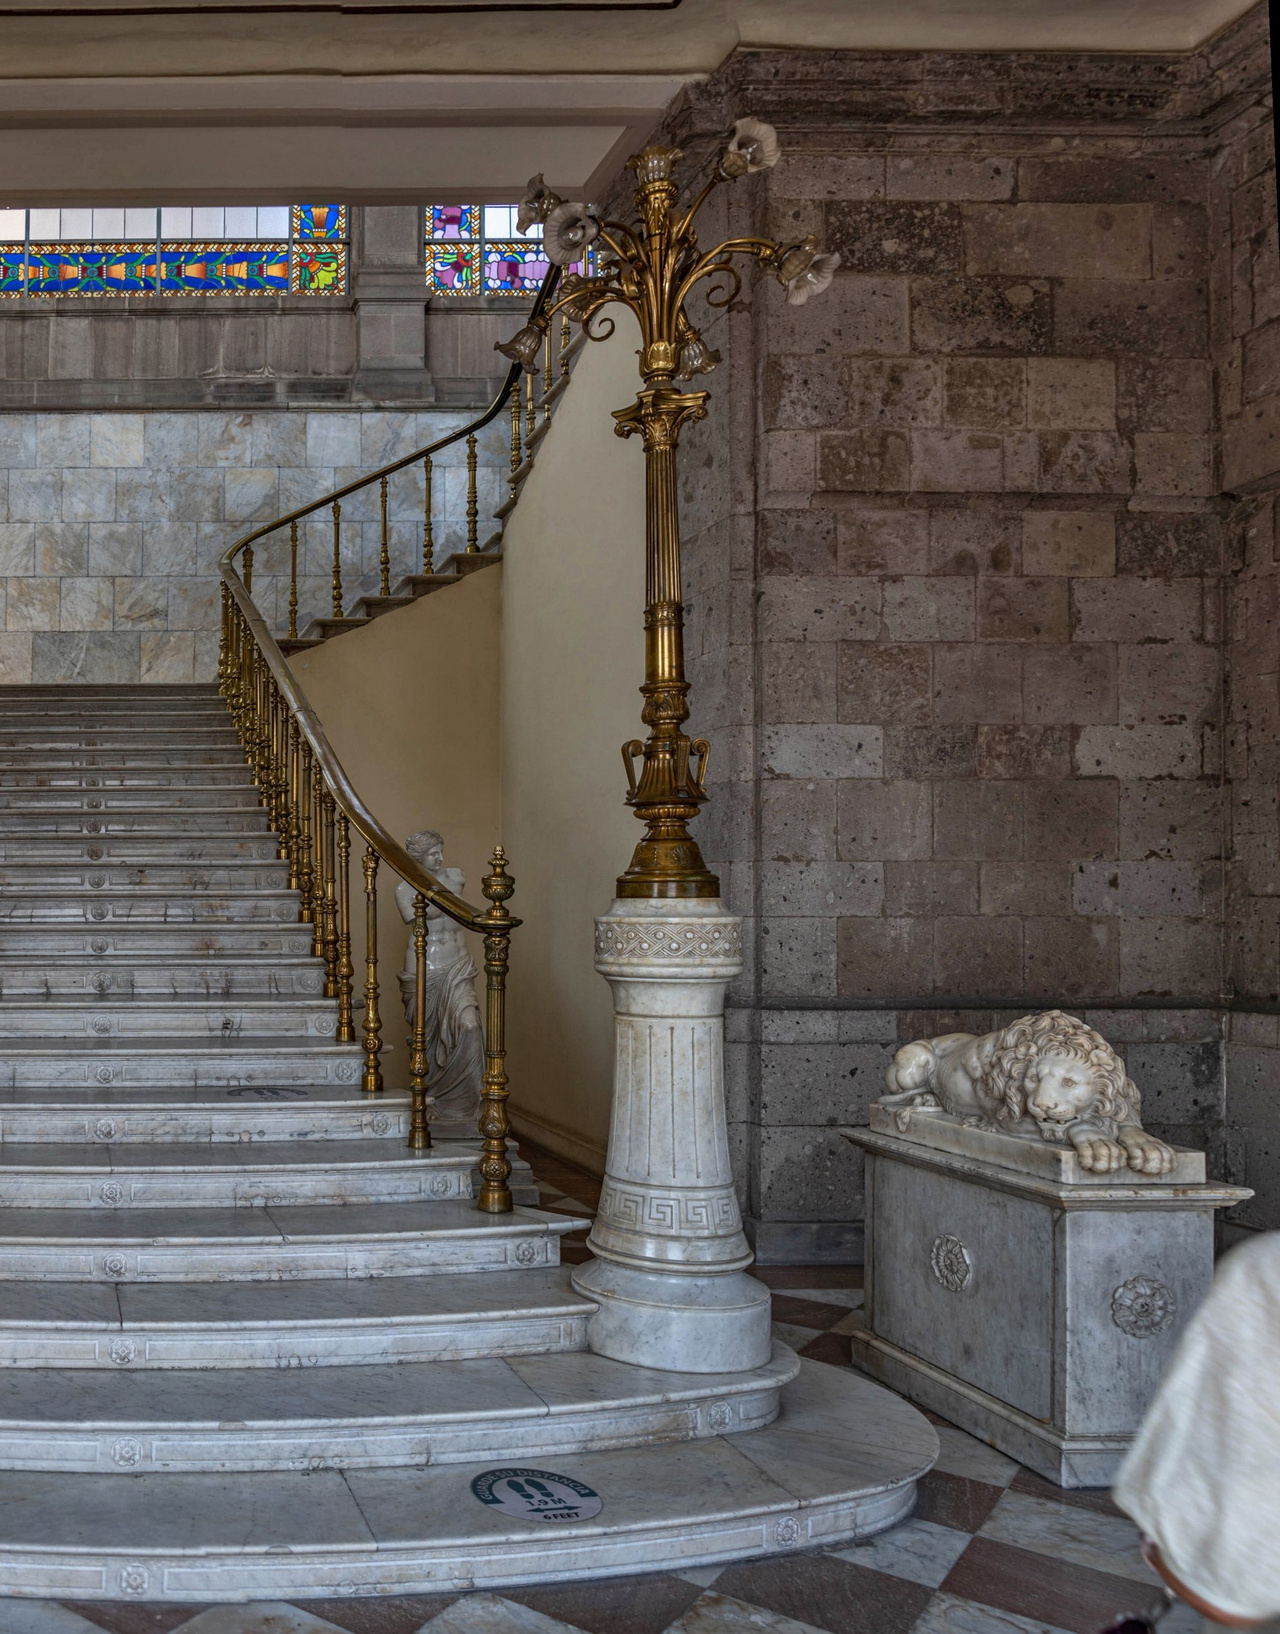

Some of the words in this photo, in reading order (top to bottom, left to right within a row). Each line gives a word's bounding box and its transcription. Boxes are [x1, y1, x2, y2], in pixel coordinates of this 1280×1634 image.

[478, 1475, 496, 1500] GUARDE
[496, 1470, 514, 1478] SU
[516, 1470, 590, 1494] DISTANCIA
[525, 1499, 549, 1507] 1.9
[553, 1497, 568, 1505] M
[552, 1511, 580, 1520] FEET
